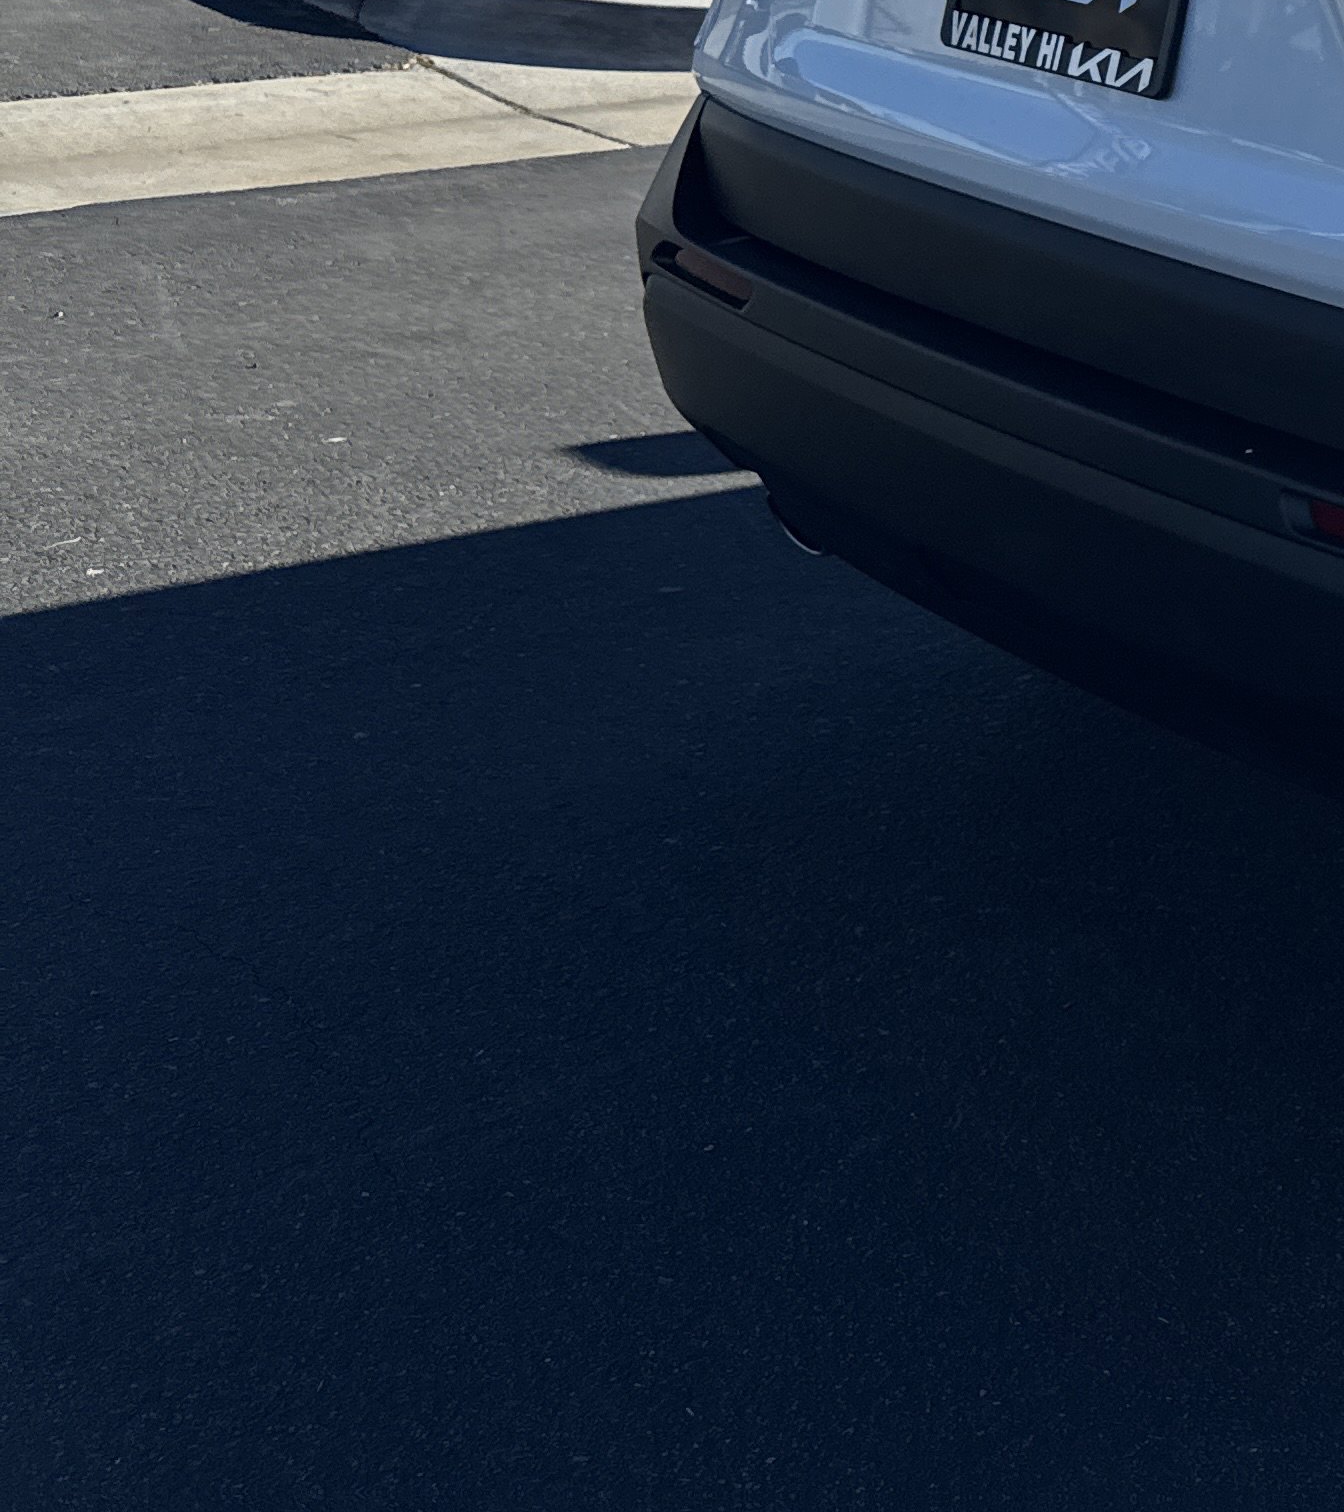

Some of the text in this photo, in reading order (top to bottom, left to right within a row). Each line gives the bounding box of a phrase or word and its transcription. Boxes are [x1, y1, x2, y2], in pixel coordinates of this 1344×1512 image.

[951, 10, 1154, 92] VALLEY HI KIA
